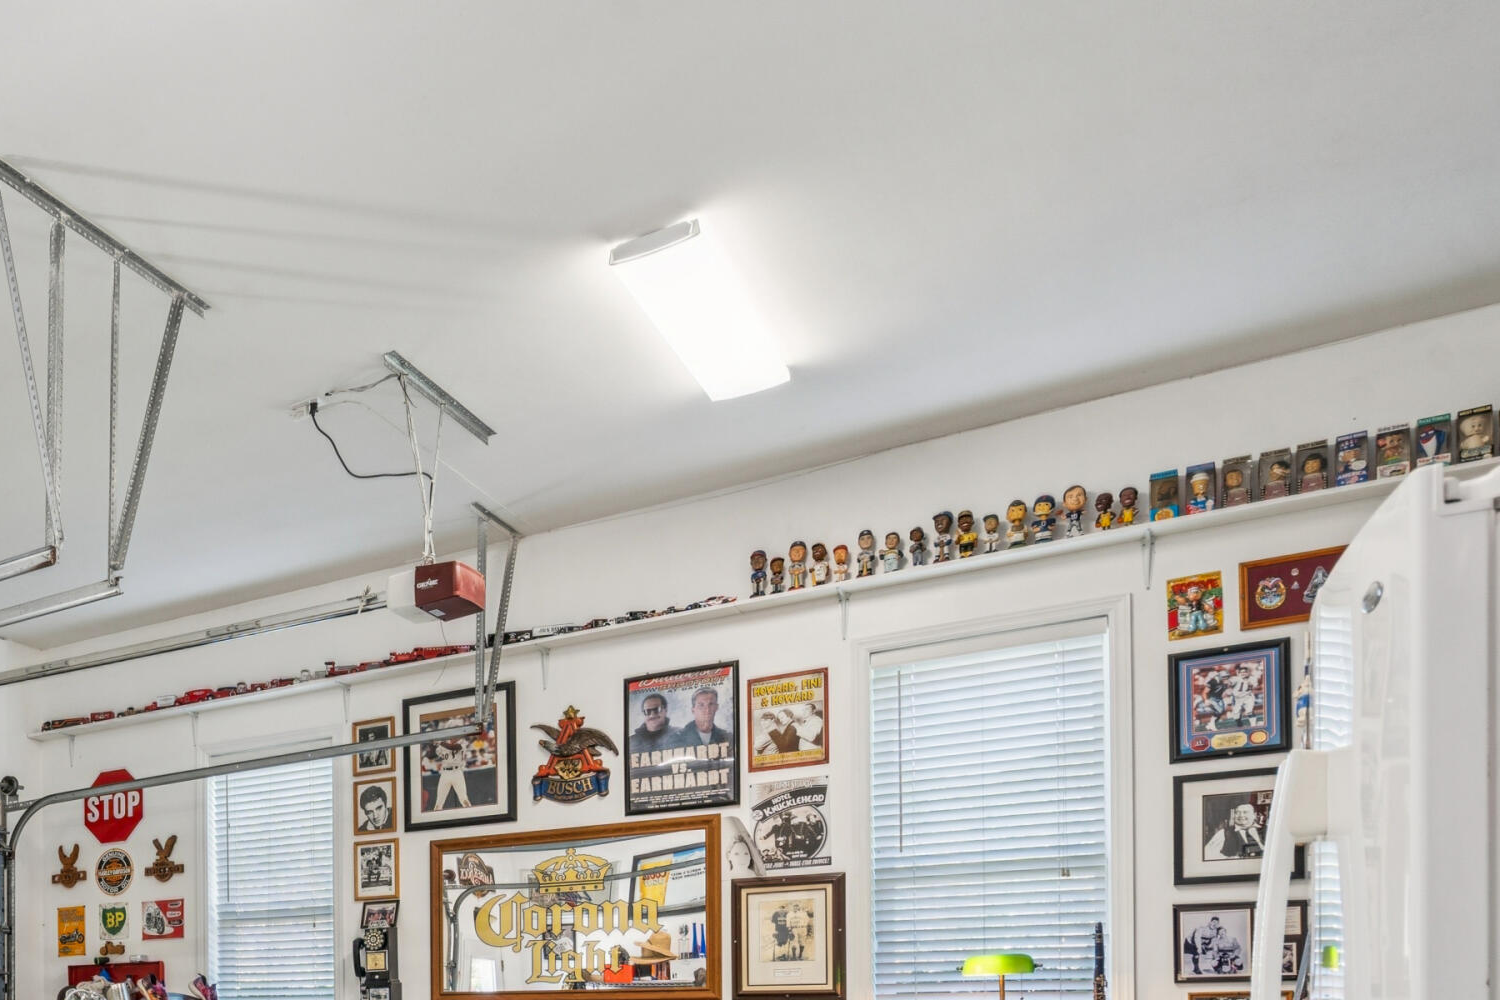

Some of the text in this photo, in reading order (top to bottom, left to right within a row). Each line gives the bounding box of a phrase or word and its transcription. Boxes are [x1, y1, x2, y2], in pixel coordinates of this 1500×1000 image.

[753, 681, 797, 697] HOWARD,
[771, 690, 814, 706] HOWARD
[631, 742, 729, 768] EARNHARDT
[672, 763, 691, 774] VS.
[547, 777, 593, 795] BUSCH
[631, 768, 729, 793] EARNHARDT
[87, 790, 140, 823] STOP
[763, 794, 824, 816] KNUCKLEHEAD
[772, 793, 791, 805] HOTEL
[106, 911, 125, 928] BP
[474, 891, 664, 953] Corona
[525, 940, 623, 984] Light
